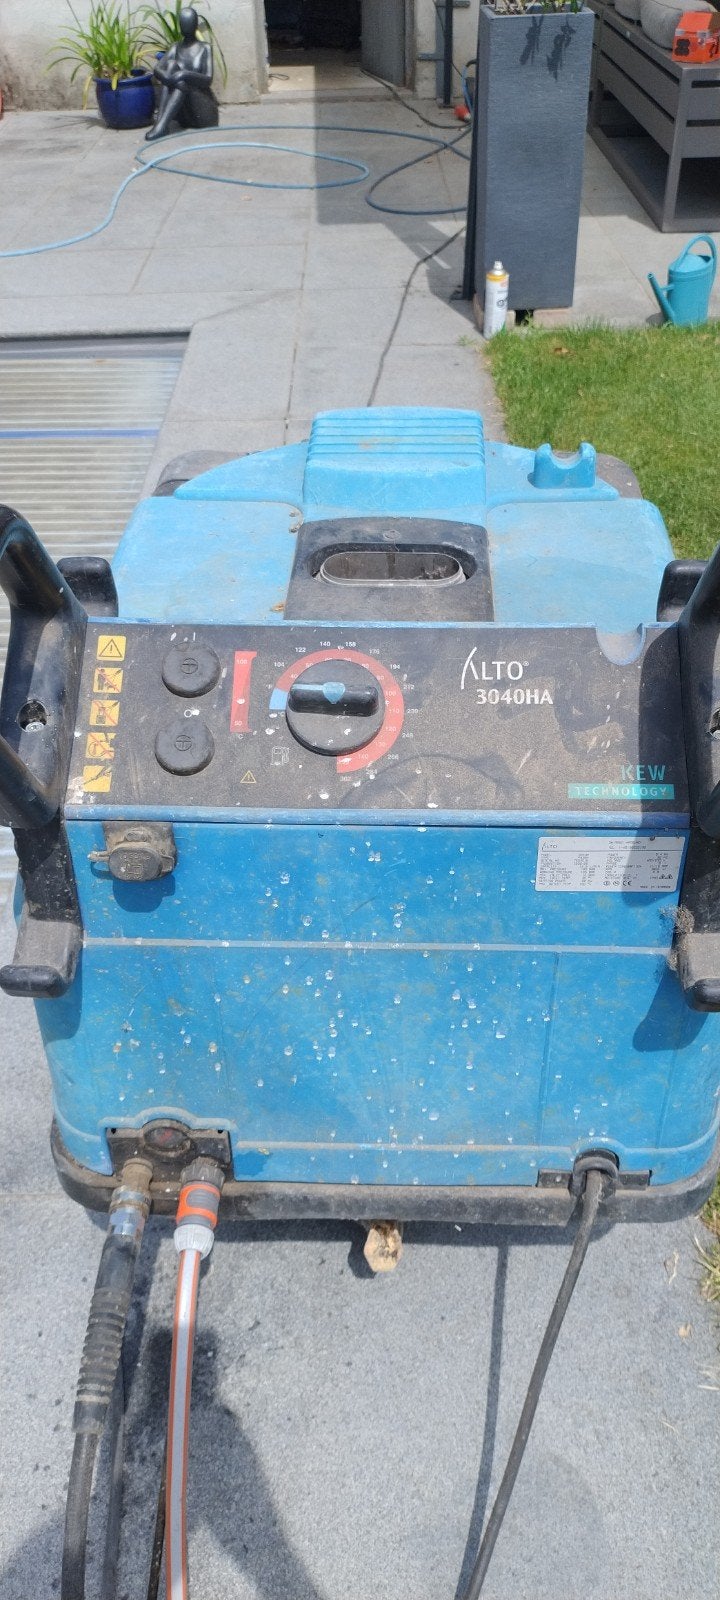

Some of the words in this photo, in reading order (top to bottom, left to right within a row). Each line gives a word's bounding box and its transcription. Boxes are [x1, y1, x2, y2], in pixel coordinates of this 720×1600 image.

[475, 688, 554, 705] 3040HA
[620, 764, 667, 782] KEW
[575, 786, 668, 797] TECHNOLOGY
